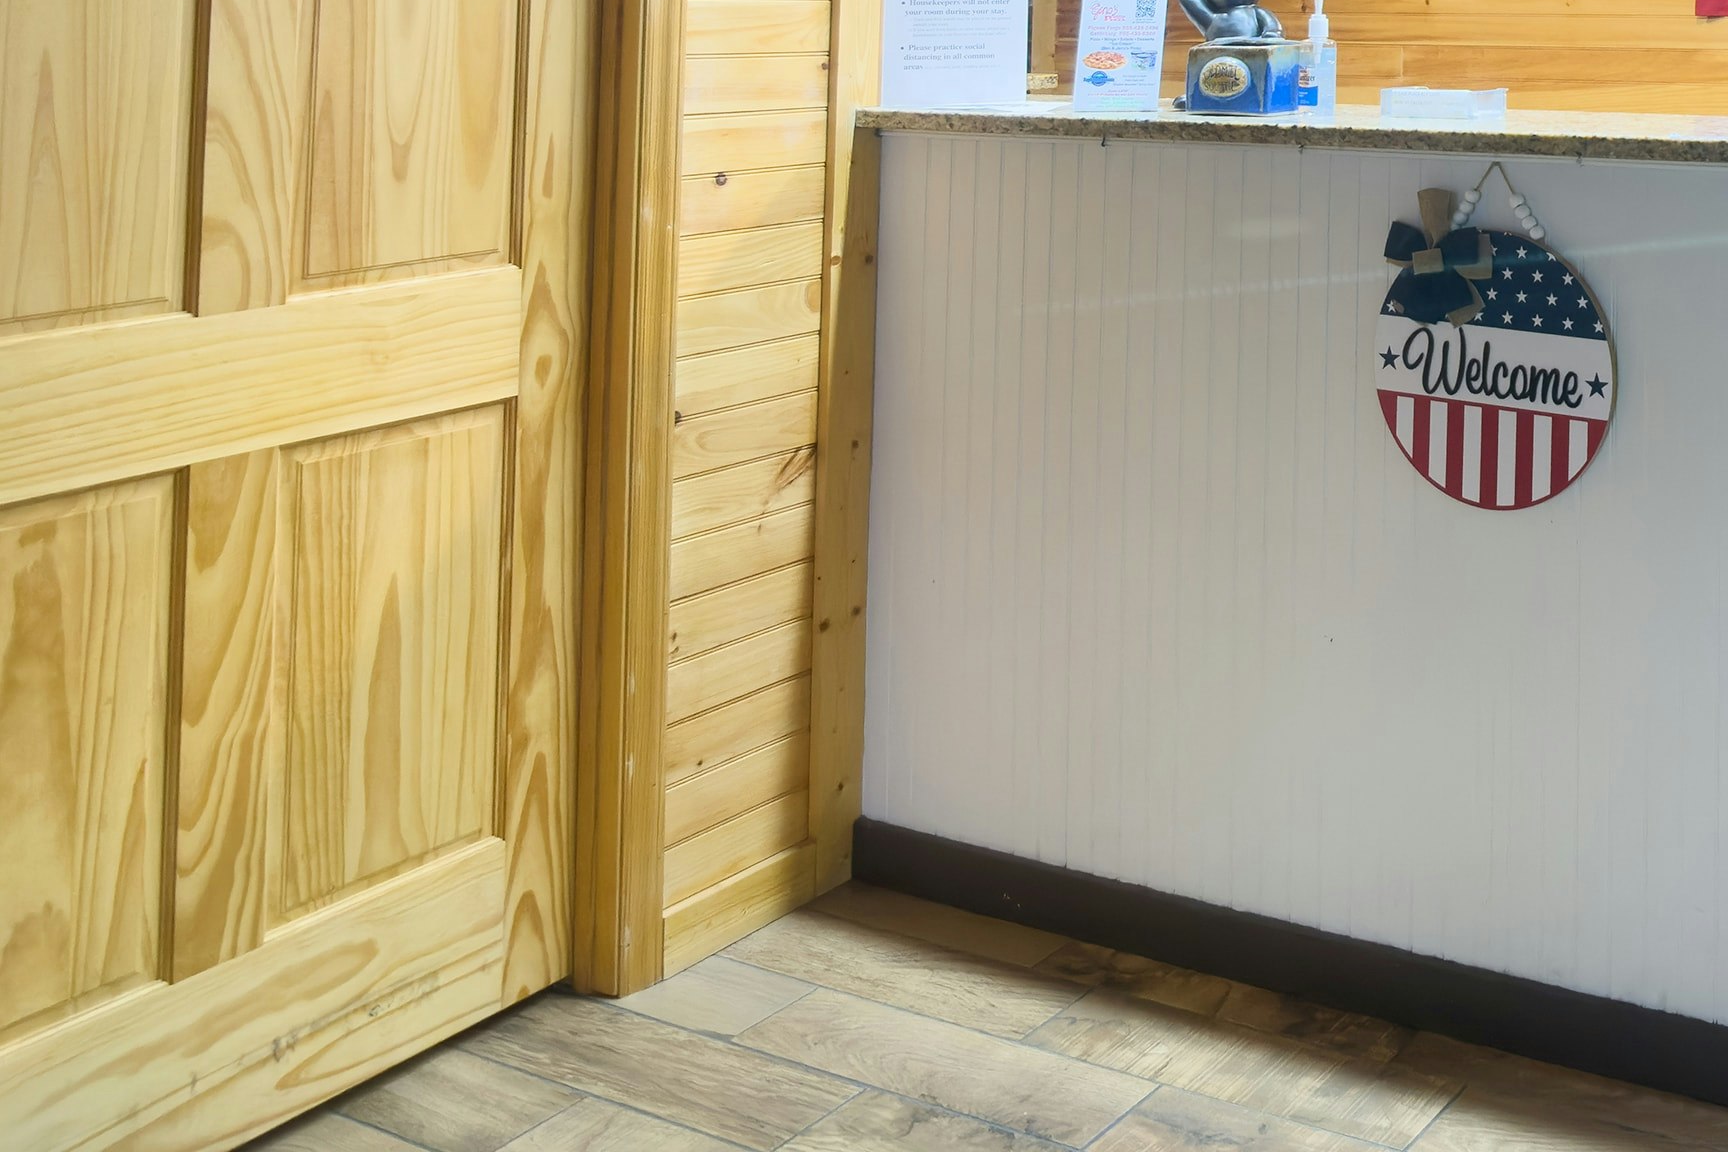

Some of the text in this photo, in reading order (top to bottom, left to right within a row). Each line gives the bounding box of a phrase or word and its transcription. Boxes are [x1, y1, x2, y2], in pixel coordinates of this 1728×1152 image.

[909, 0, 961, 7] Housekeepers
[945, 8, 971, 16] during
[990, 8, 1008, 16] stay.
[933, 44, 963, 52] practice
[903, 53, 942, 61] distancing
[1402, 326, 1584, 409] Welcome
